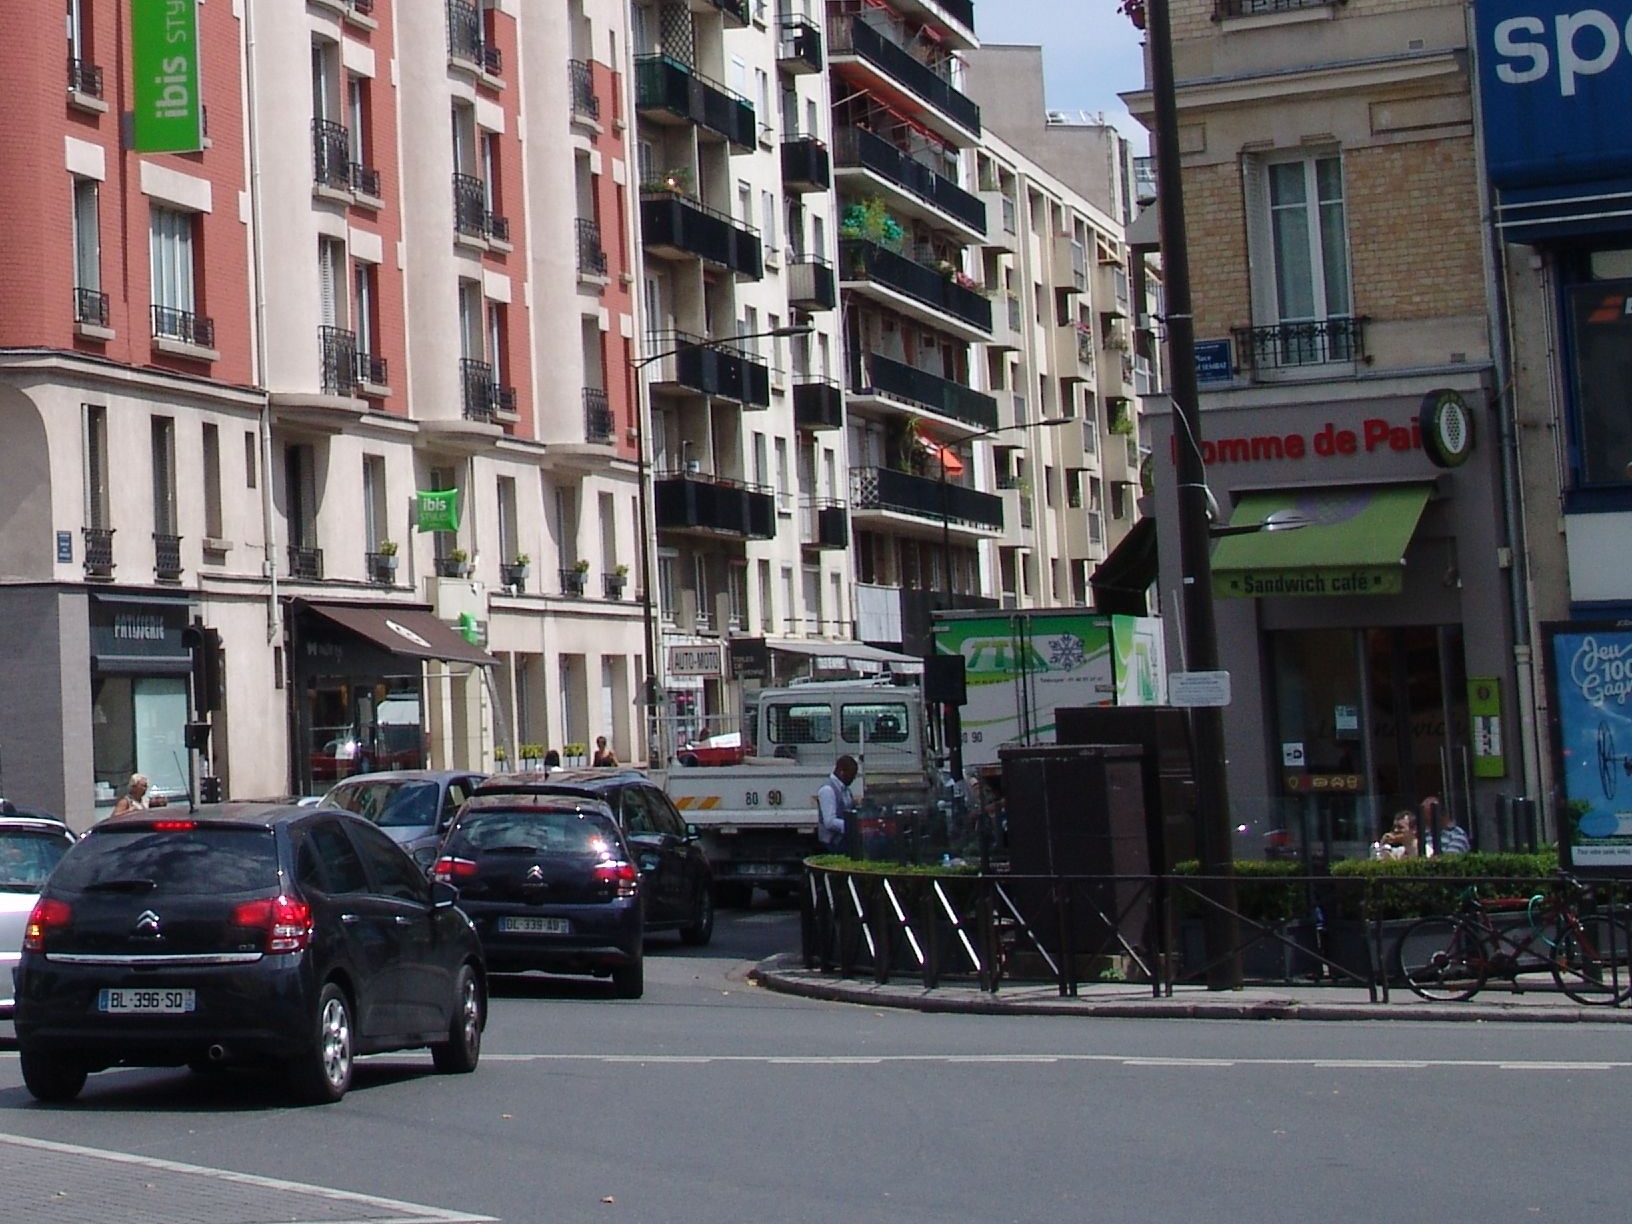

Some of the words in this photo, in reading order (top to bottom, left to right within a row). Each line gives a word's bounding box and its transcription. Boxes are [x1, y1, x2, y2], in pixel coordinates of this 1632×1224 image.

[155, 56, 189, 118] ibis
[1171, 432, 1305, 465] omme
[1314, 423, 1357, 456] de
[1363, 416, 1422, 453] Pai
[423, 497, 446, 511] ibis
[1244, 575, 1326, 594] Sandwich
[1333, 573, 1368, 591] café
[675, 651, 718, 670] AUTO-MOTO
[971, 732, 982, 743] 90
[769, 790, 782, 805] 90
